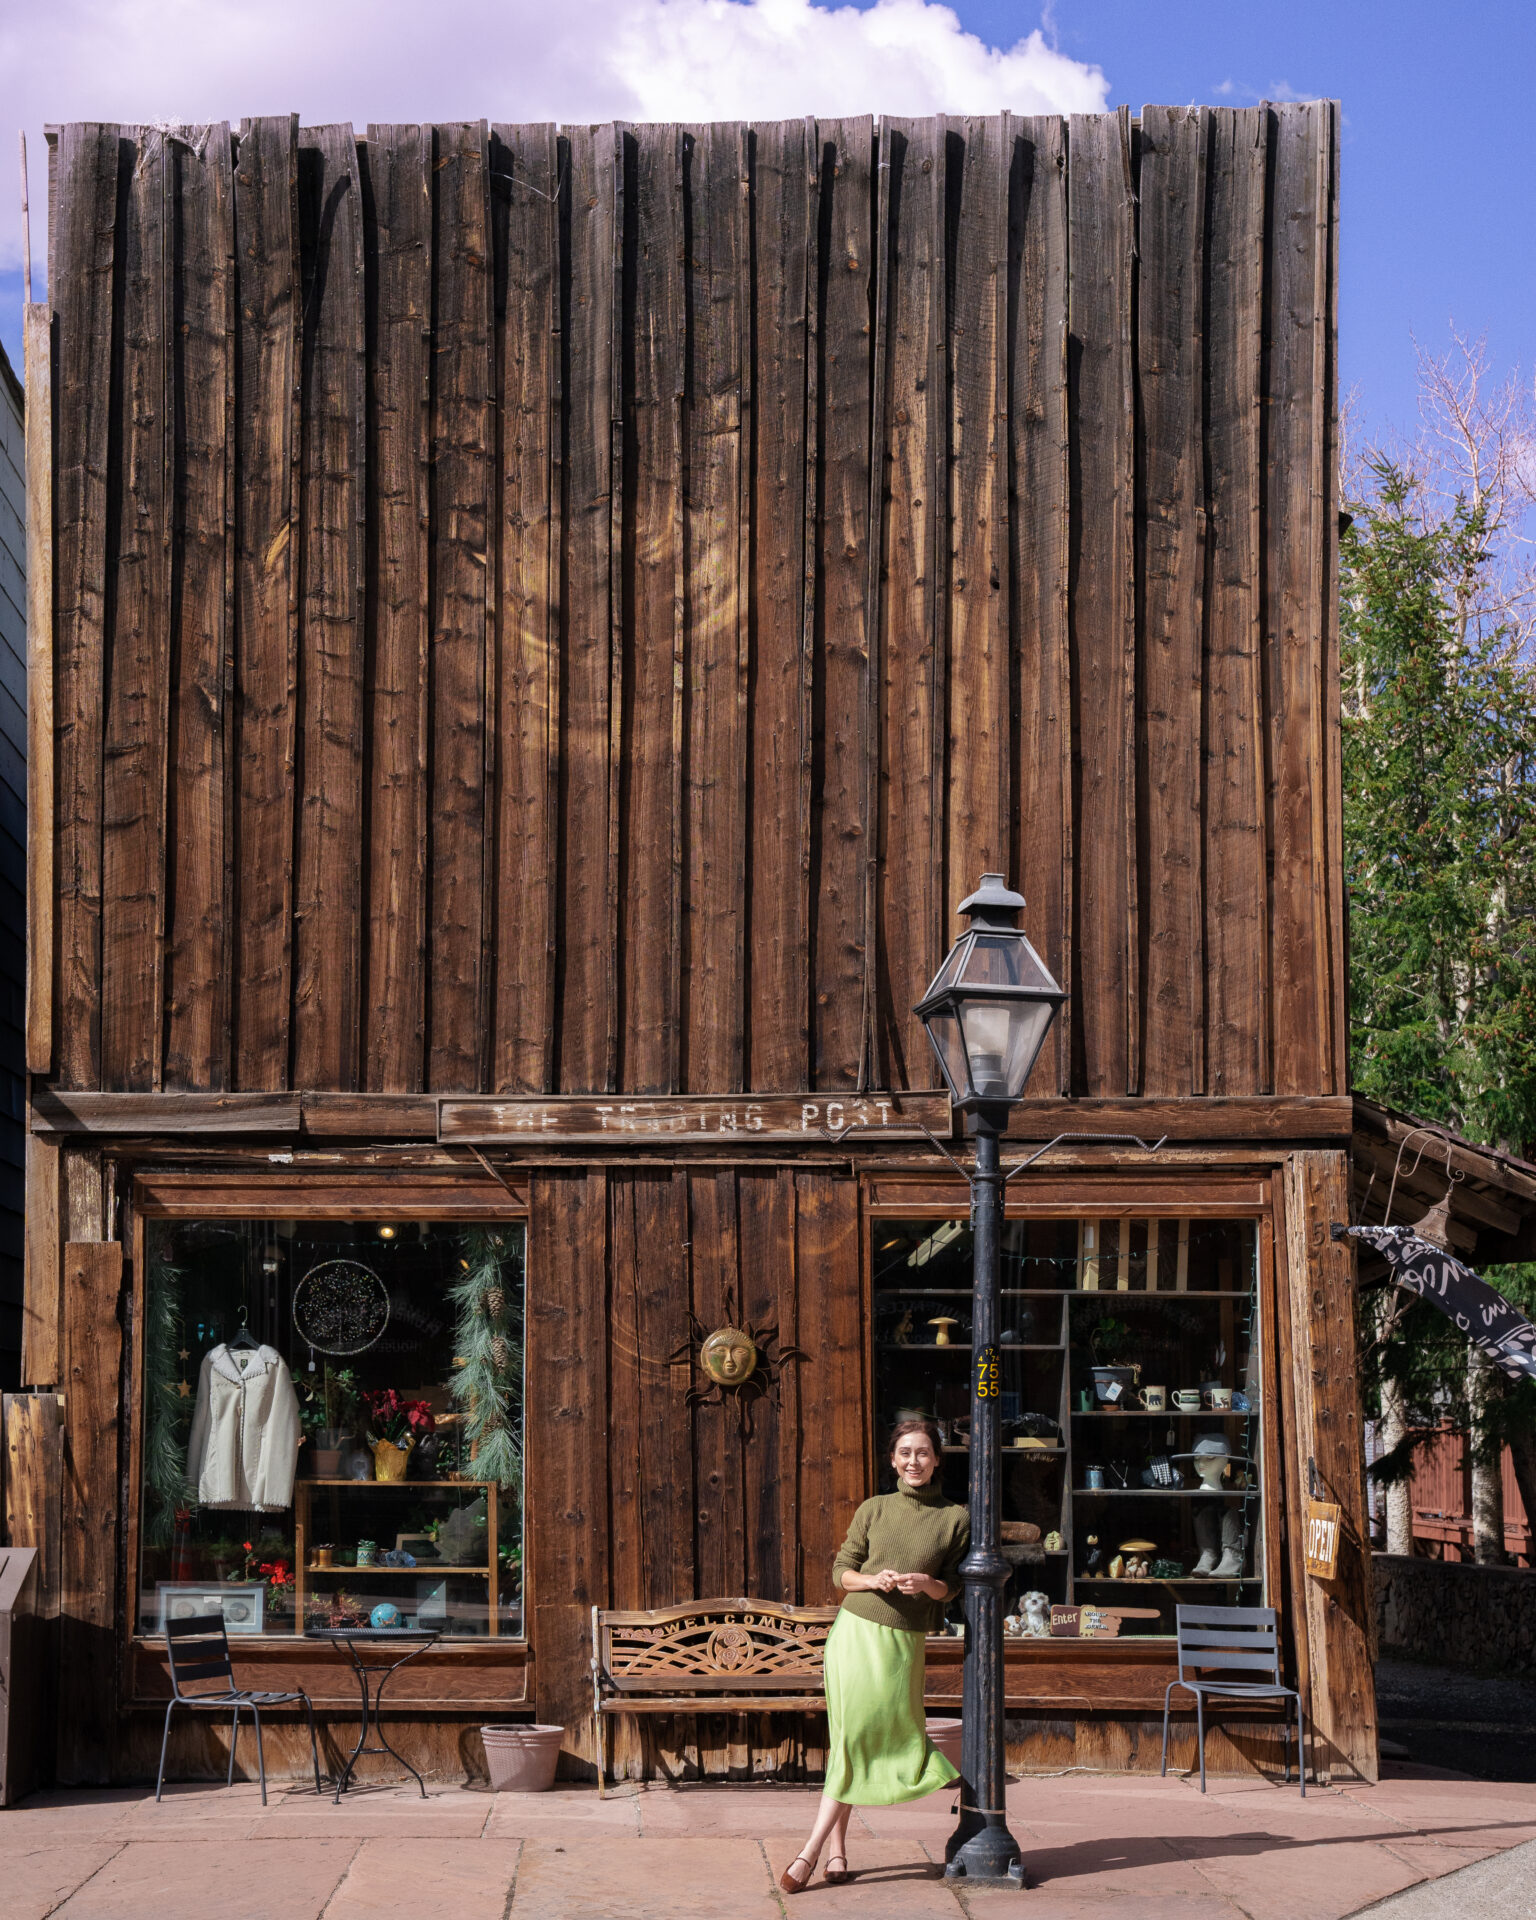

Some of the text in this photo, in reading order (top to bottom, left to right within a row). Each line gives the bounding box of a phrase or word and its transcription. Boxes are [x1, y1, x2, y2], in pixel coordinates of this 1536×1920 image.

[801, 1101, 892, 1131] POST
[977, 1363, 999, 1380] 75
[977, 1381, 999, 1398] 55
[1308, 1517, 1335, 1564] OPEN
[664, 1614, 796, 1635] WELCOME
[1052, 1612, 1078, 1626] Enter
